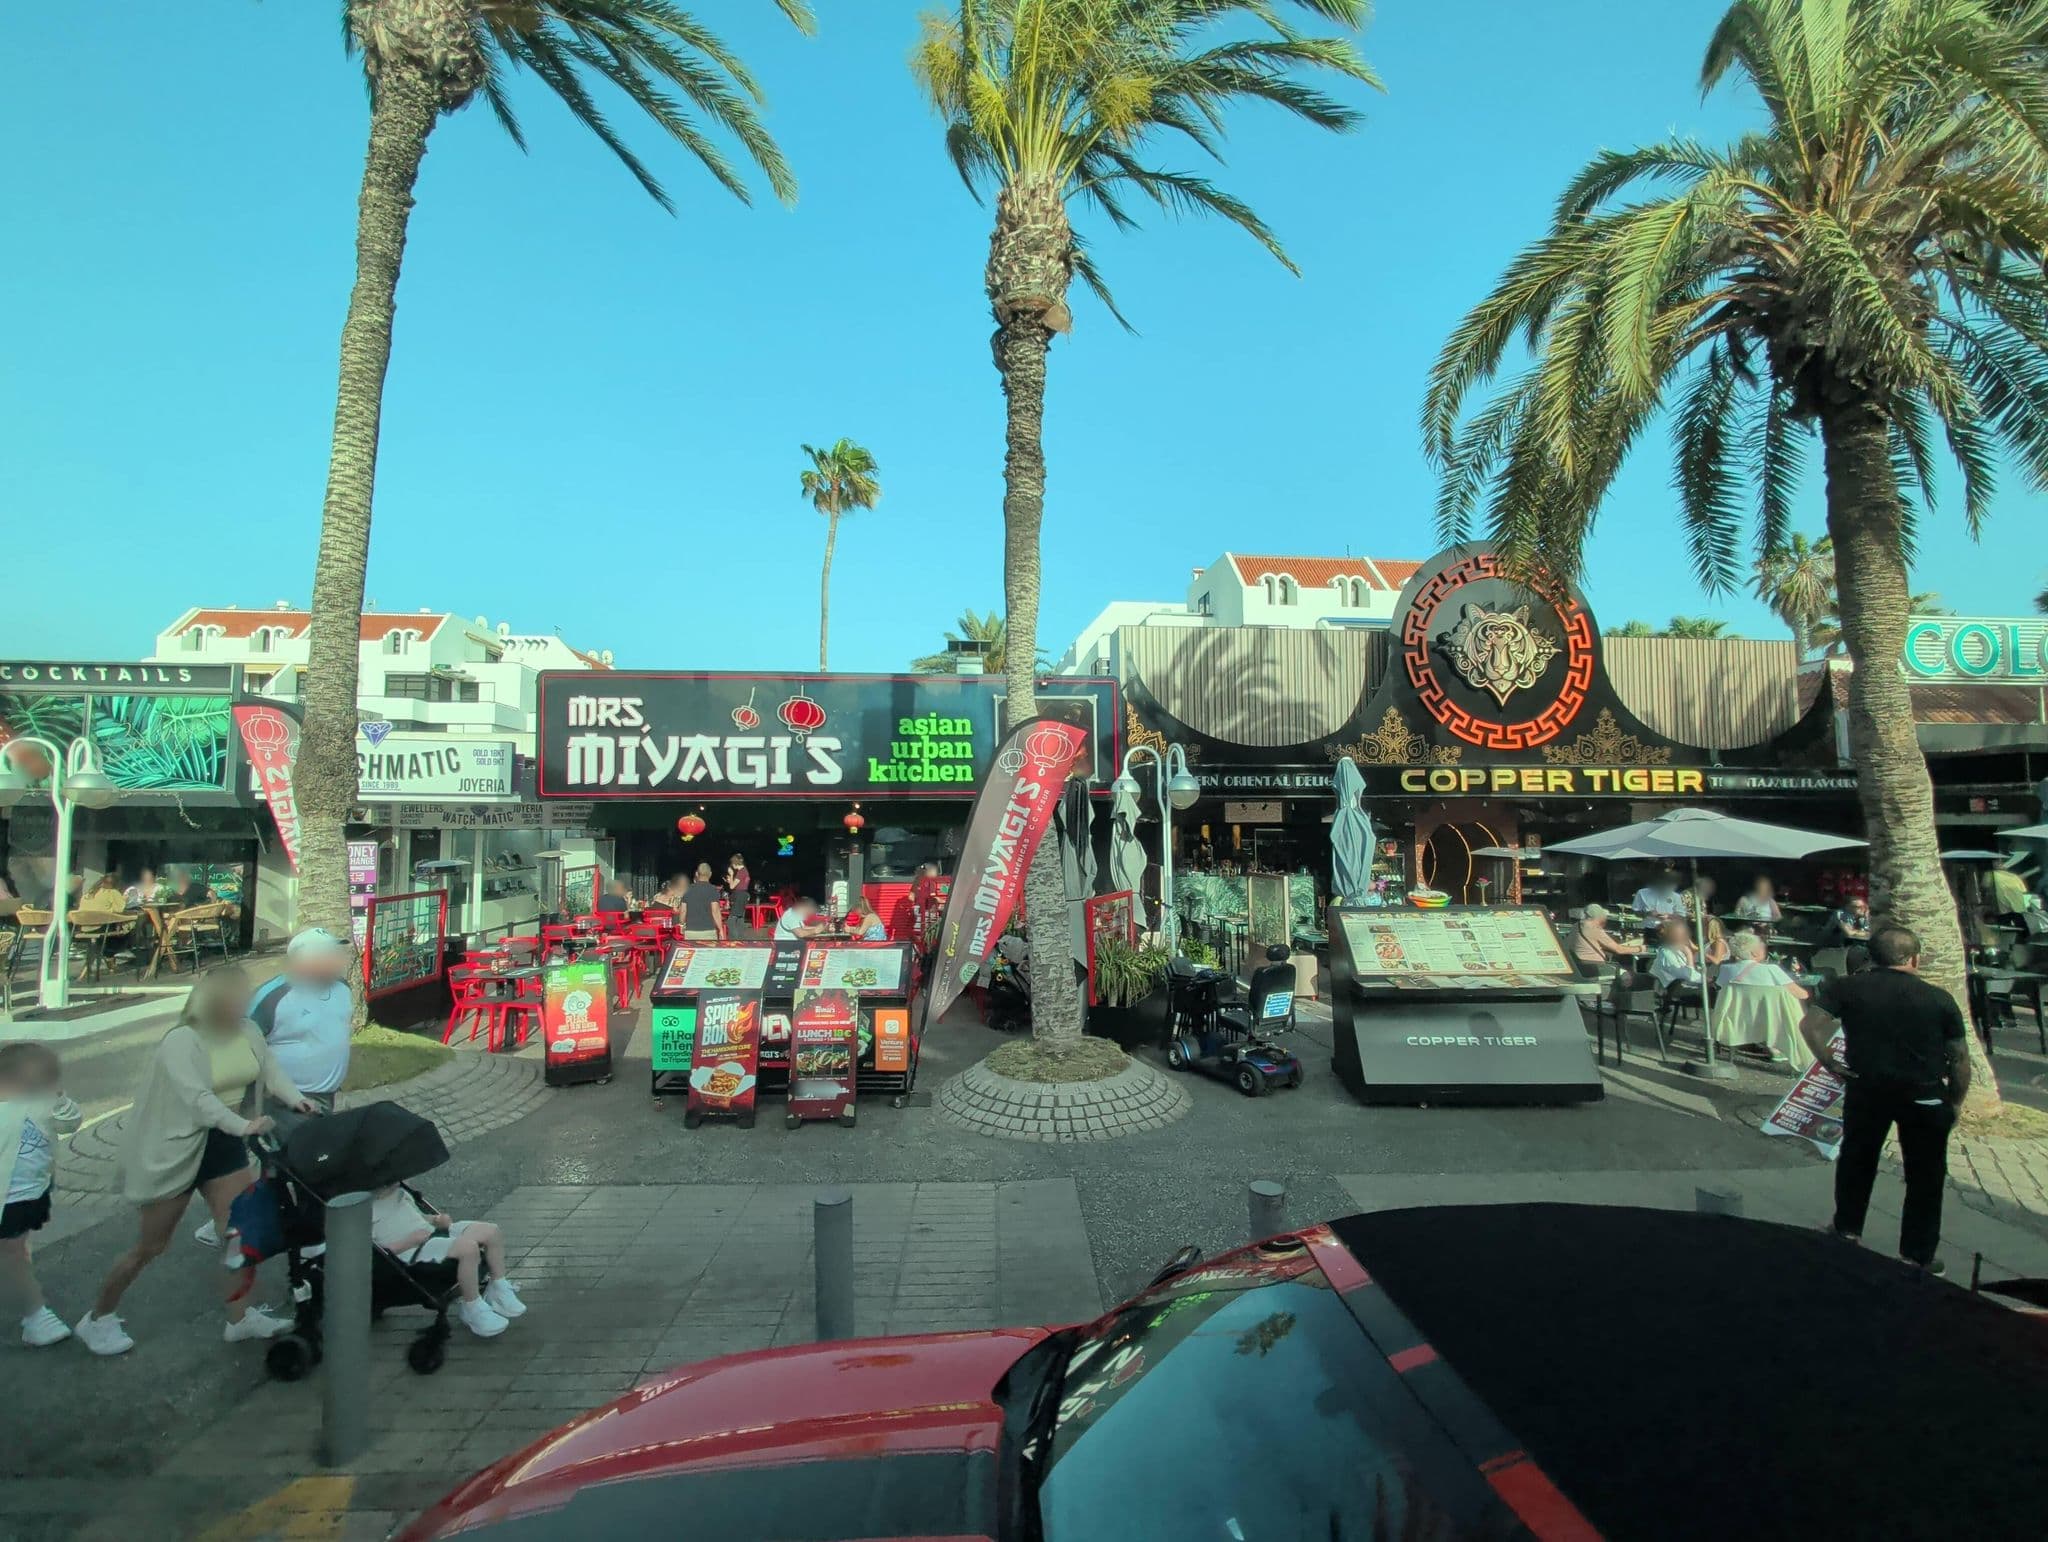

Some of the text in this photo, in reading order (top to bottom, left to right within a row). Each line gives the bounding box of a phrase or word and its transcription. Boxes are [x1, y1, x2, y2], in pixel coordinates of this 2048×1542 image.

[1905, 623, 2048, 676] COL
[0, 667, 192, 683] COCKTAILS
[899, 712, 973, 735] asian
[891, 735, 973, 759] urban
[567, 732, 843, 788] MIYAGI'S
[868, 758, 973, 782] kitchen
[458, 778, 505, 792] JOYERIA
[1223, 775, 1291, 787] ORIENTAL
[1400, 769, 1575, 793] COPPER
[1582, 769, 1703, 793] TIGER
[442, 811, 514, 826] WATCH MATIC
[662, 1030, 675, 1040] #1
[797, 1029, 832, 1039] LUNCH
[1407, 1036, 1537, 1046] COPPER TIGER
[662, 1041, 671, 1051] in
